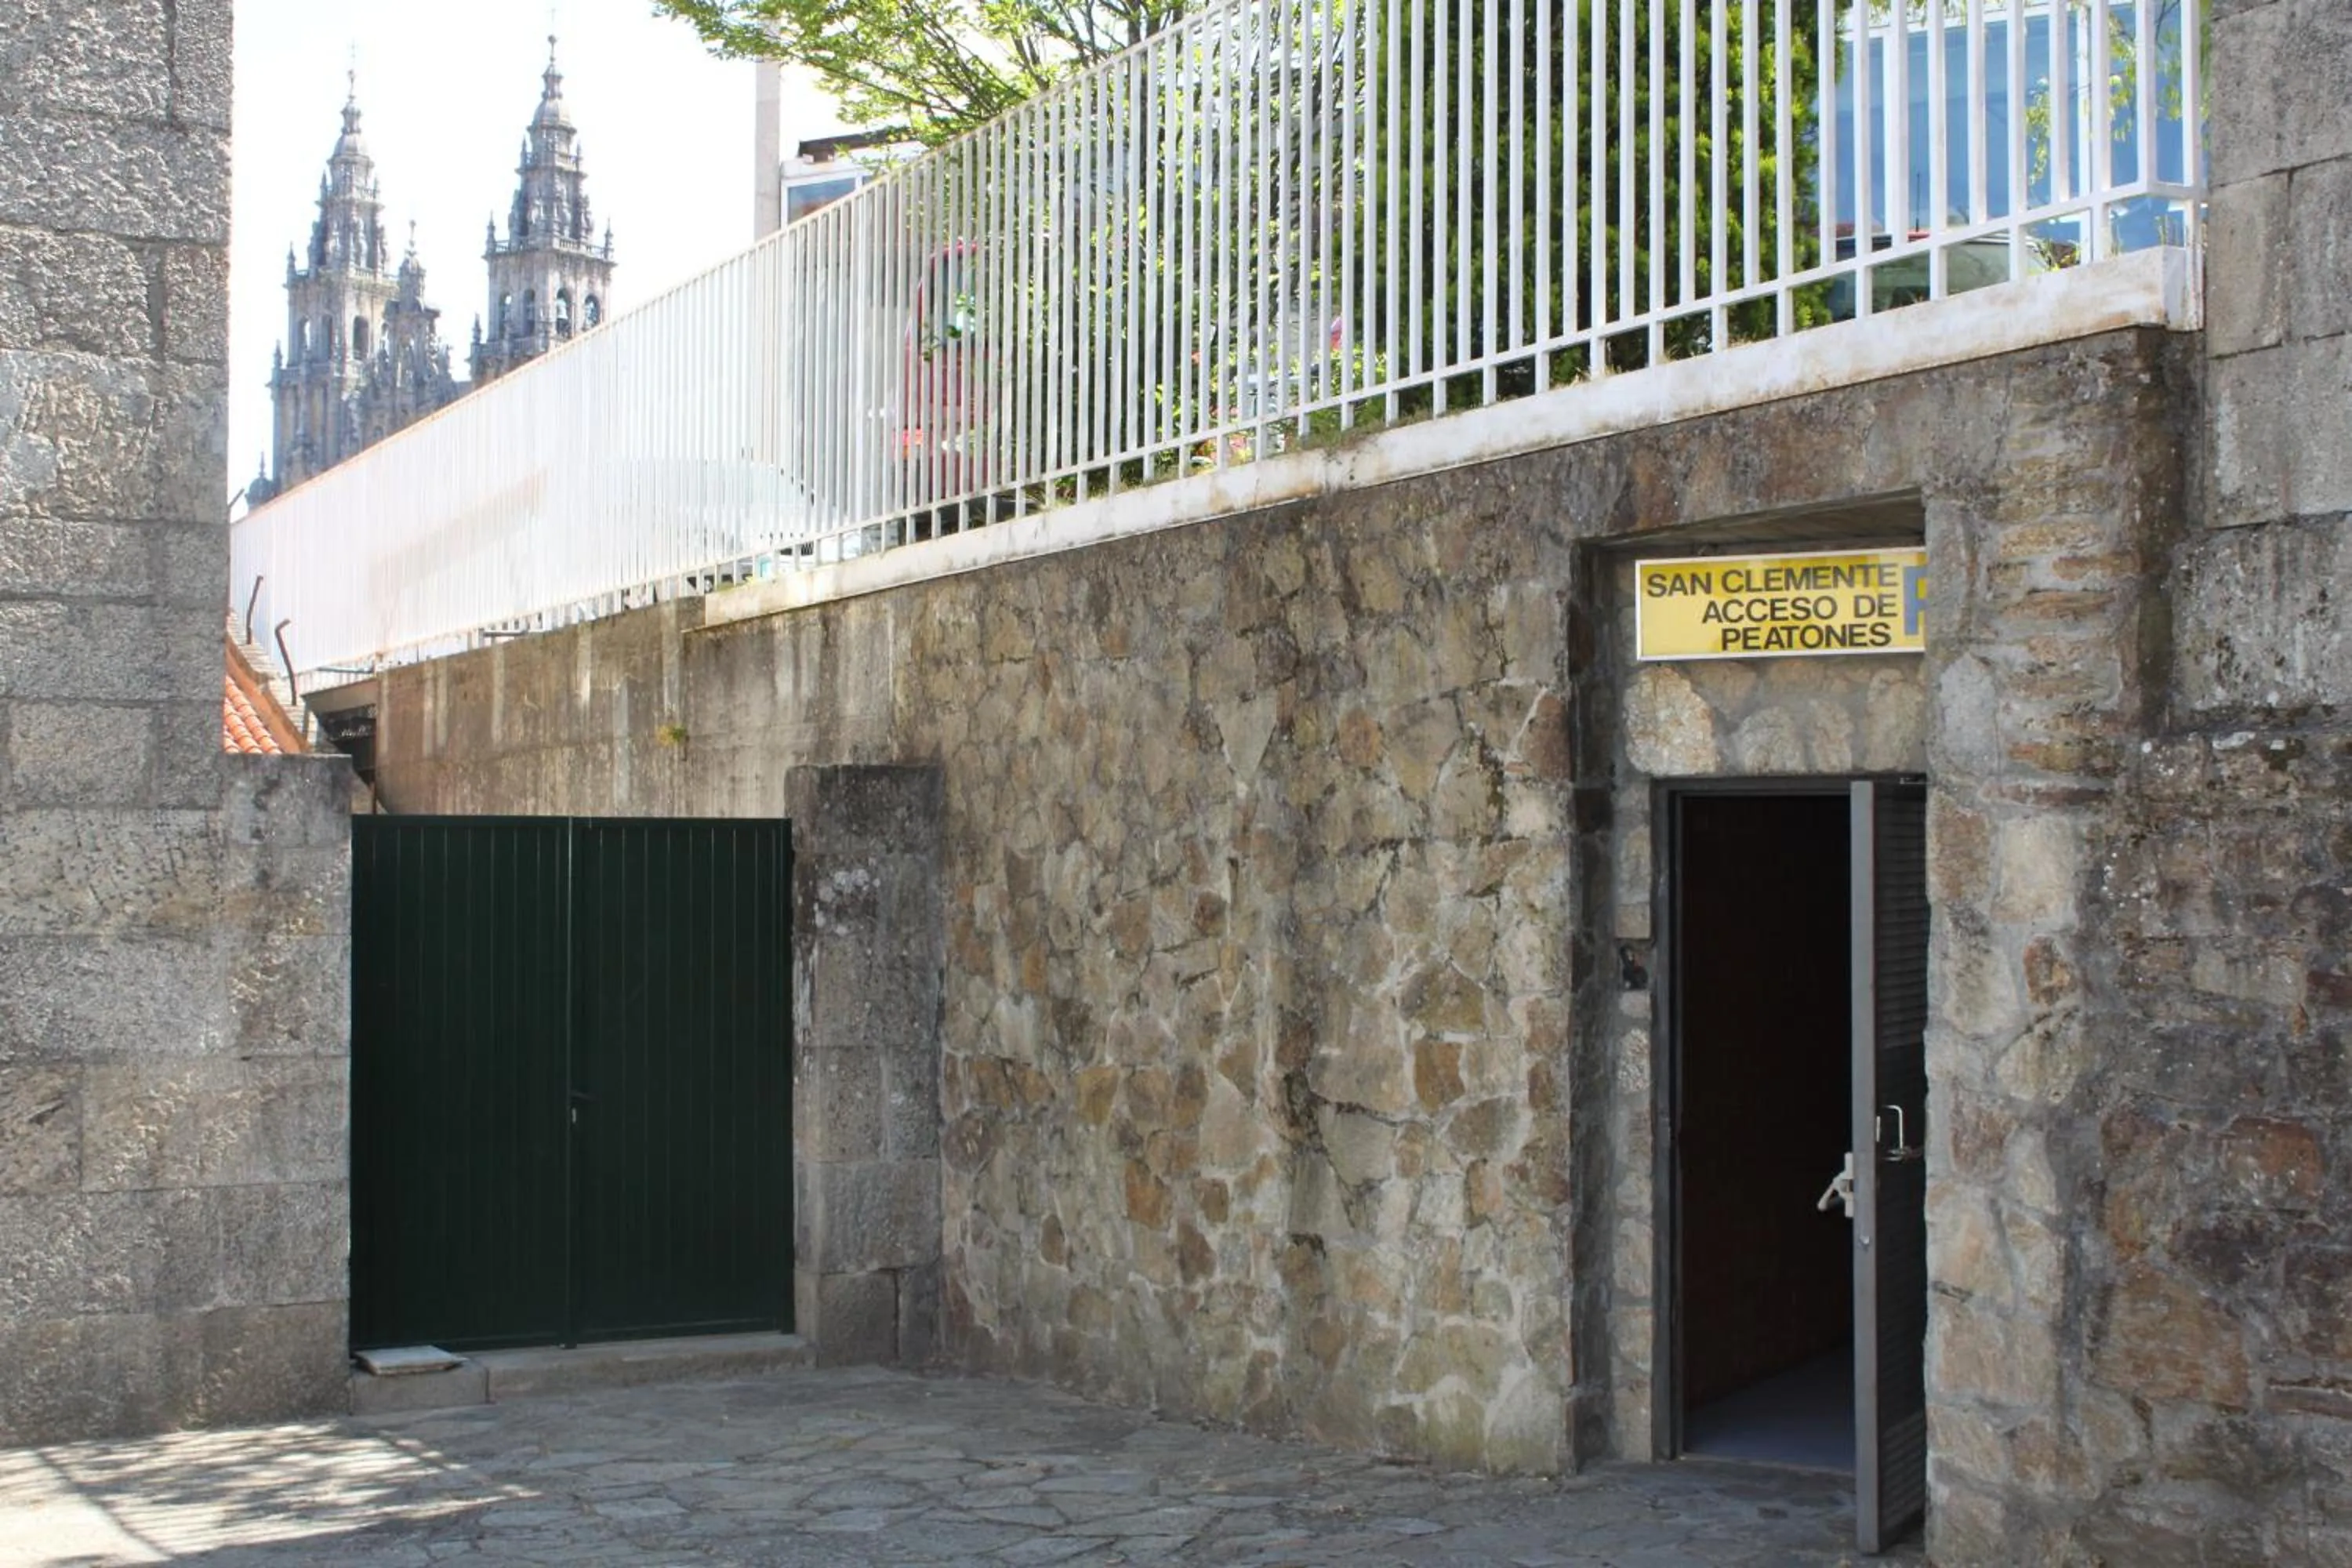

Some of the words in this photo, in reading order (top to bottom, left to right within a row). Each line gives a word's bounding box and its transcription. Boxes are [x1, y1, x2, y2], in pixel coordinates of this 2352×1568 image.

[1647, 572, 1712, 597] SAN
[1721, 563, 1898, 593] CLEMENTE
[1702, 596, 1837, 623] ACCESO
[1853, 593, 1897, 619] DE
[1722, 622, 1892, 651] PEATONES
